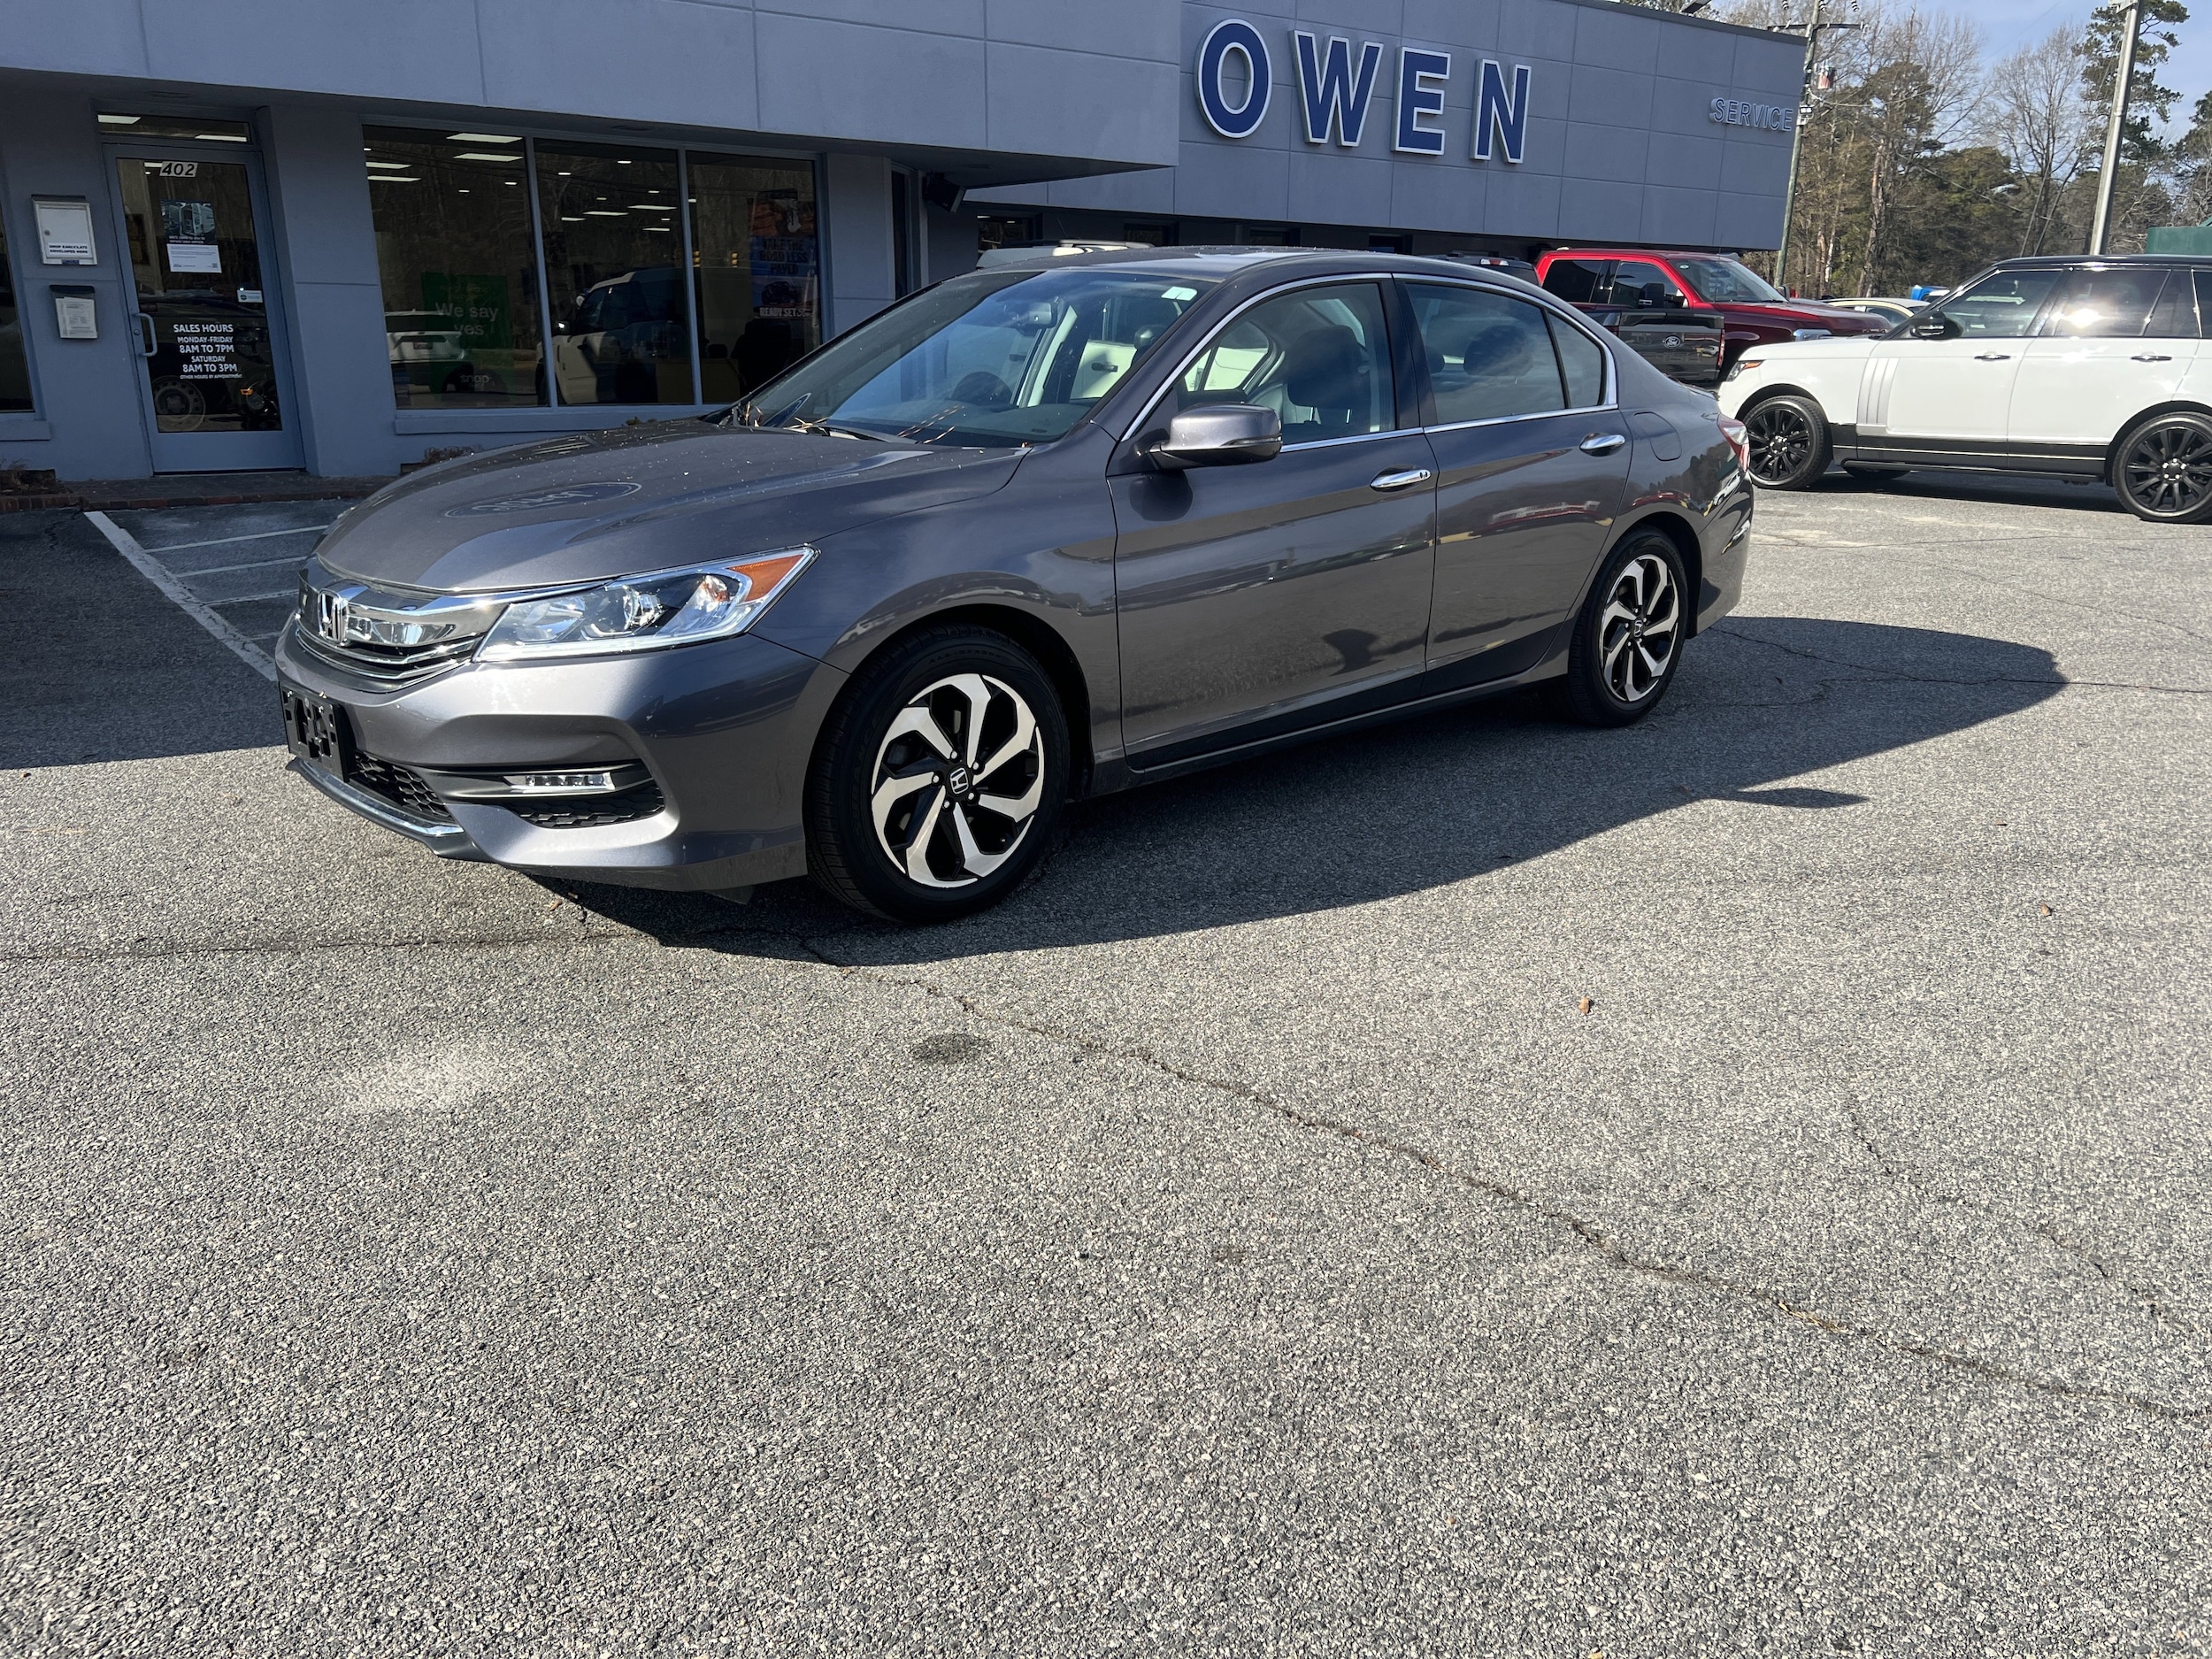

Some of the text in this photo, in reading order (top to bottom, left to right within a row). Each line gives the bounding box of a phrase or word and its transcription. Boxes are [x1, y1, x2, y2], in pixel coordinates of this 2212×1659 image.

[1196, 18, 1532, 165] OWEN
[1709, 97, 1793, 132] SERVICE
[161, 162, 196, 176] 402
[435, 302, 499, 322] We say
[759, 307, 783, 318] READY
[784, 308, 796, 318] SET
[173, 324, 234, 333] SALES HOURS
[179, 344, 234, 353] 8AM TO 7PM
[182, 364, 204, 373] 8AM
[204, 364, 217, 373] TO
